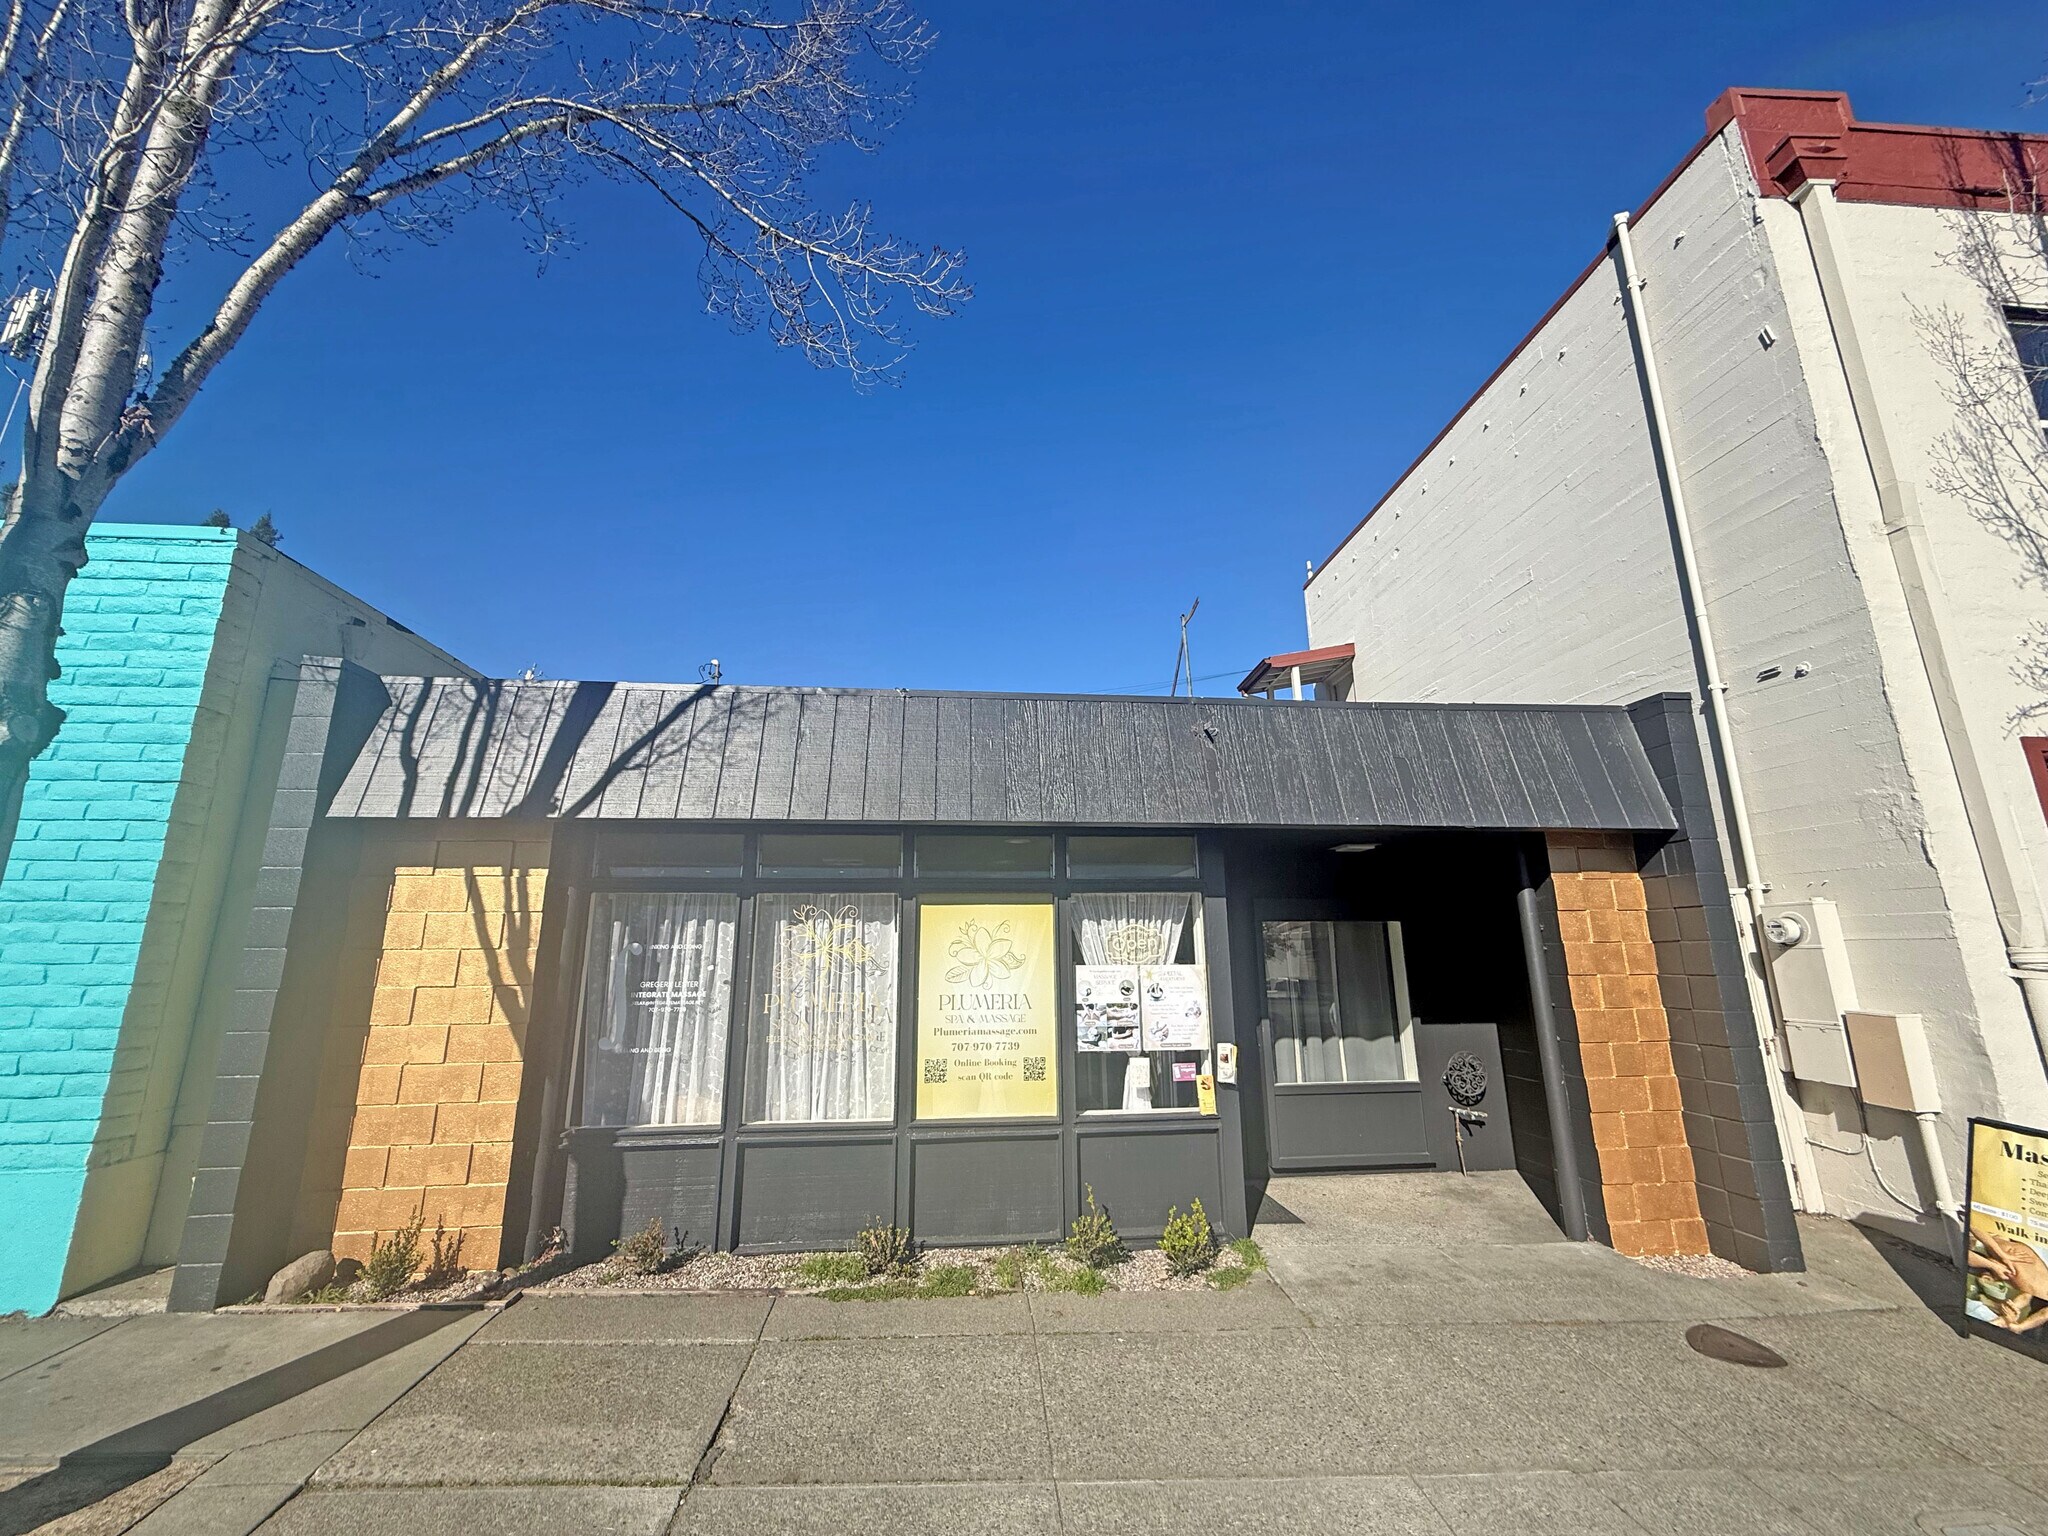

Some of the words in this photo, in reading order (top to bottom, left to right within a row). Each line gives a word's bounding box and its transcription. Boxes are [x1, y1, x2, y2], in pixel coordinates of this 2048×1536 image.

[1113, 938, 1157, 955] Open
[674, 980, 699, 988] LETER
[938, 993, 1033, 1011] PLUMERIA
[944, 1014, 964, 1024] SPA
[966, 1014, 976, 1024] &
[979, 1013, 1027, 1024] MASSAGE
[933, 1027, 1038, 1037] Plumeriamassage.com
[953, 1058, 982, 1067] Online
[984, 1058, 1017, 1068] Booking
[978, 1072, 992, 1083] QR
[994, 1071, 1014, 1081] code
[2000, 1140, 2048, 1166] Mas
[1995, 1220, 2029, 1239] Walk
